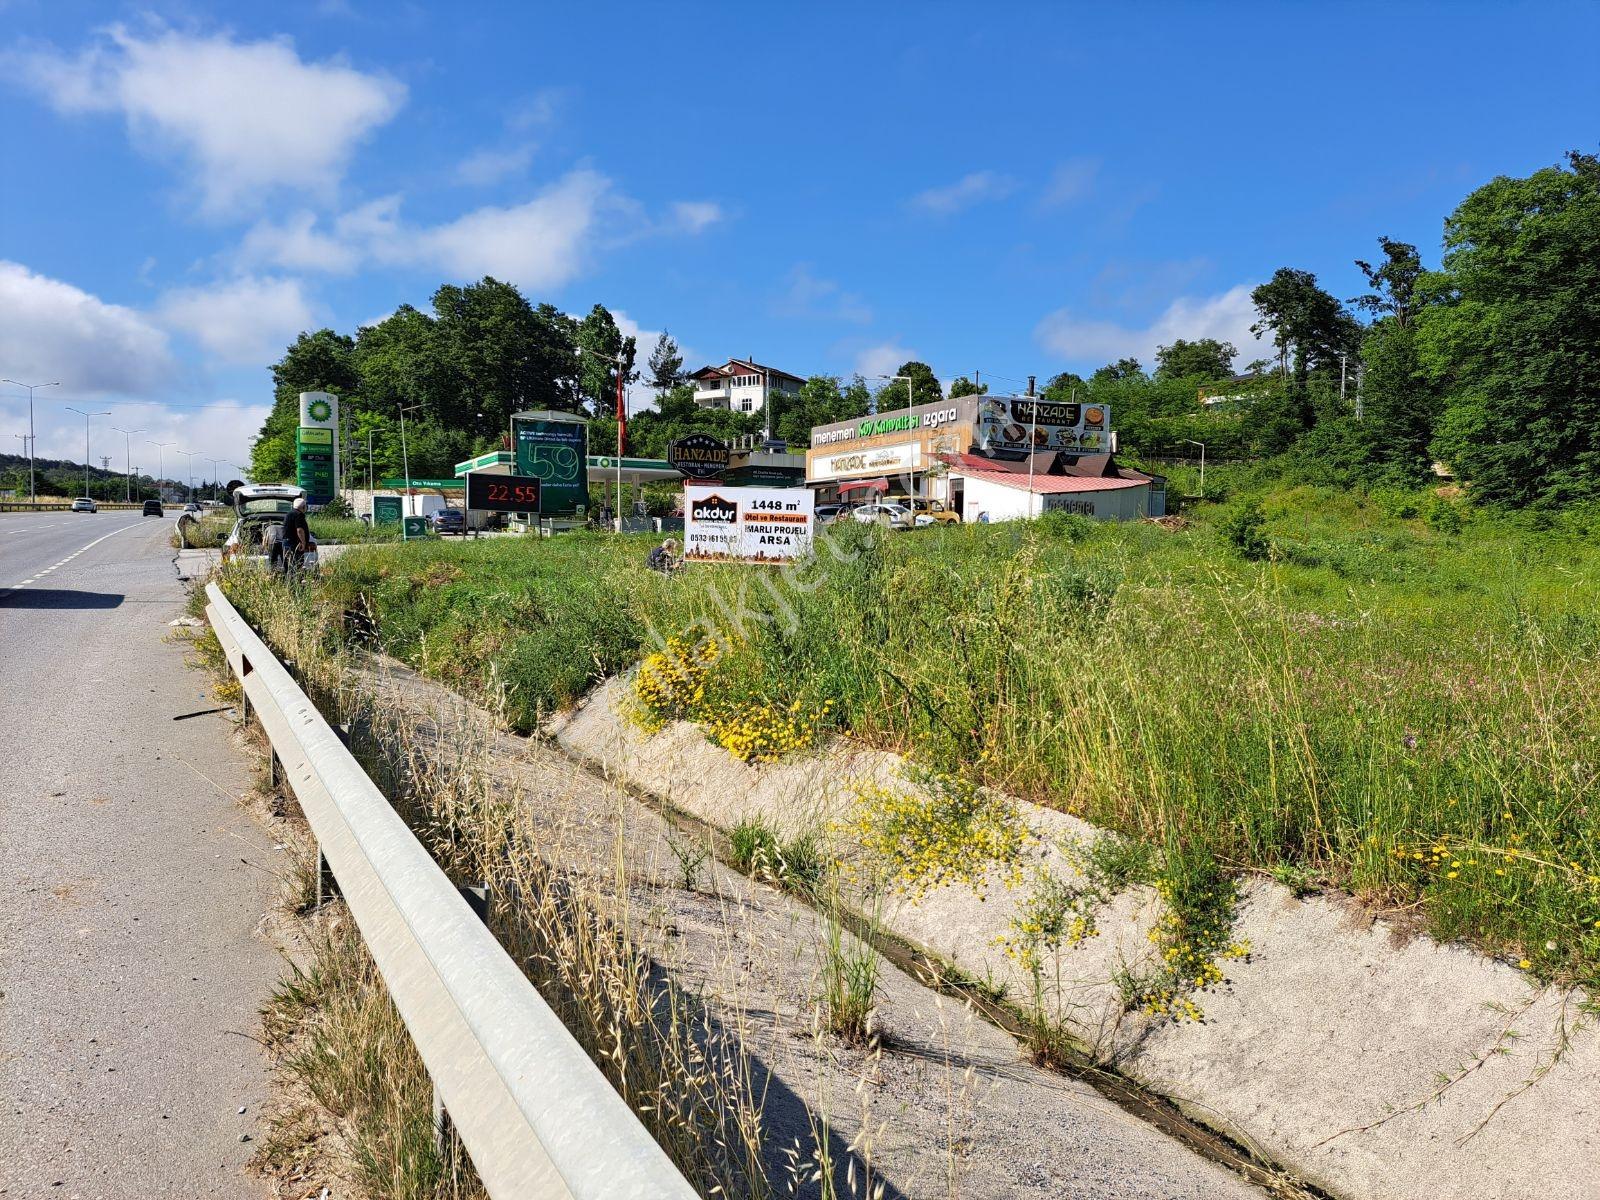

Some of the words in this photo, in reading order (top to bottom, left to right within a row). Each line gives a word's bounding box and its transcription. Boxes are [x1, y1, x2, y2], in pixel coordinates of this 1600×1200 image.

[1017, 402, 1075, 419] HANZADE
[1021, 416, 1071, 425] RETAURANT
[814, 426, 856, 444] menemen
[858, 420, 874, 437] Köy
[874, 415, 920, 433] Kahvaltsı
[528, 442, 579, 480] 59
[673, 446, 728, 462] HANZADE
[488, 484, 536, 502] 22.55
[751, 500, 782, 510] 1448
[693, 506, 734, 520] akdur
[745, 513, 759, 521] Otel
[769, 514, 807, 523] Restaurant
[759, 535, 791, 545] ARSA
